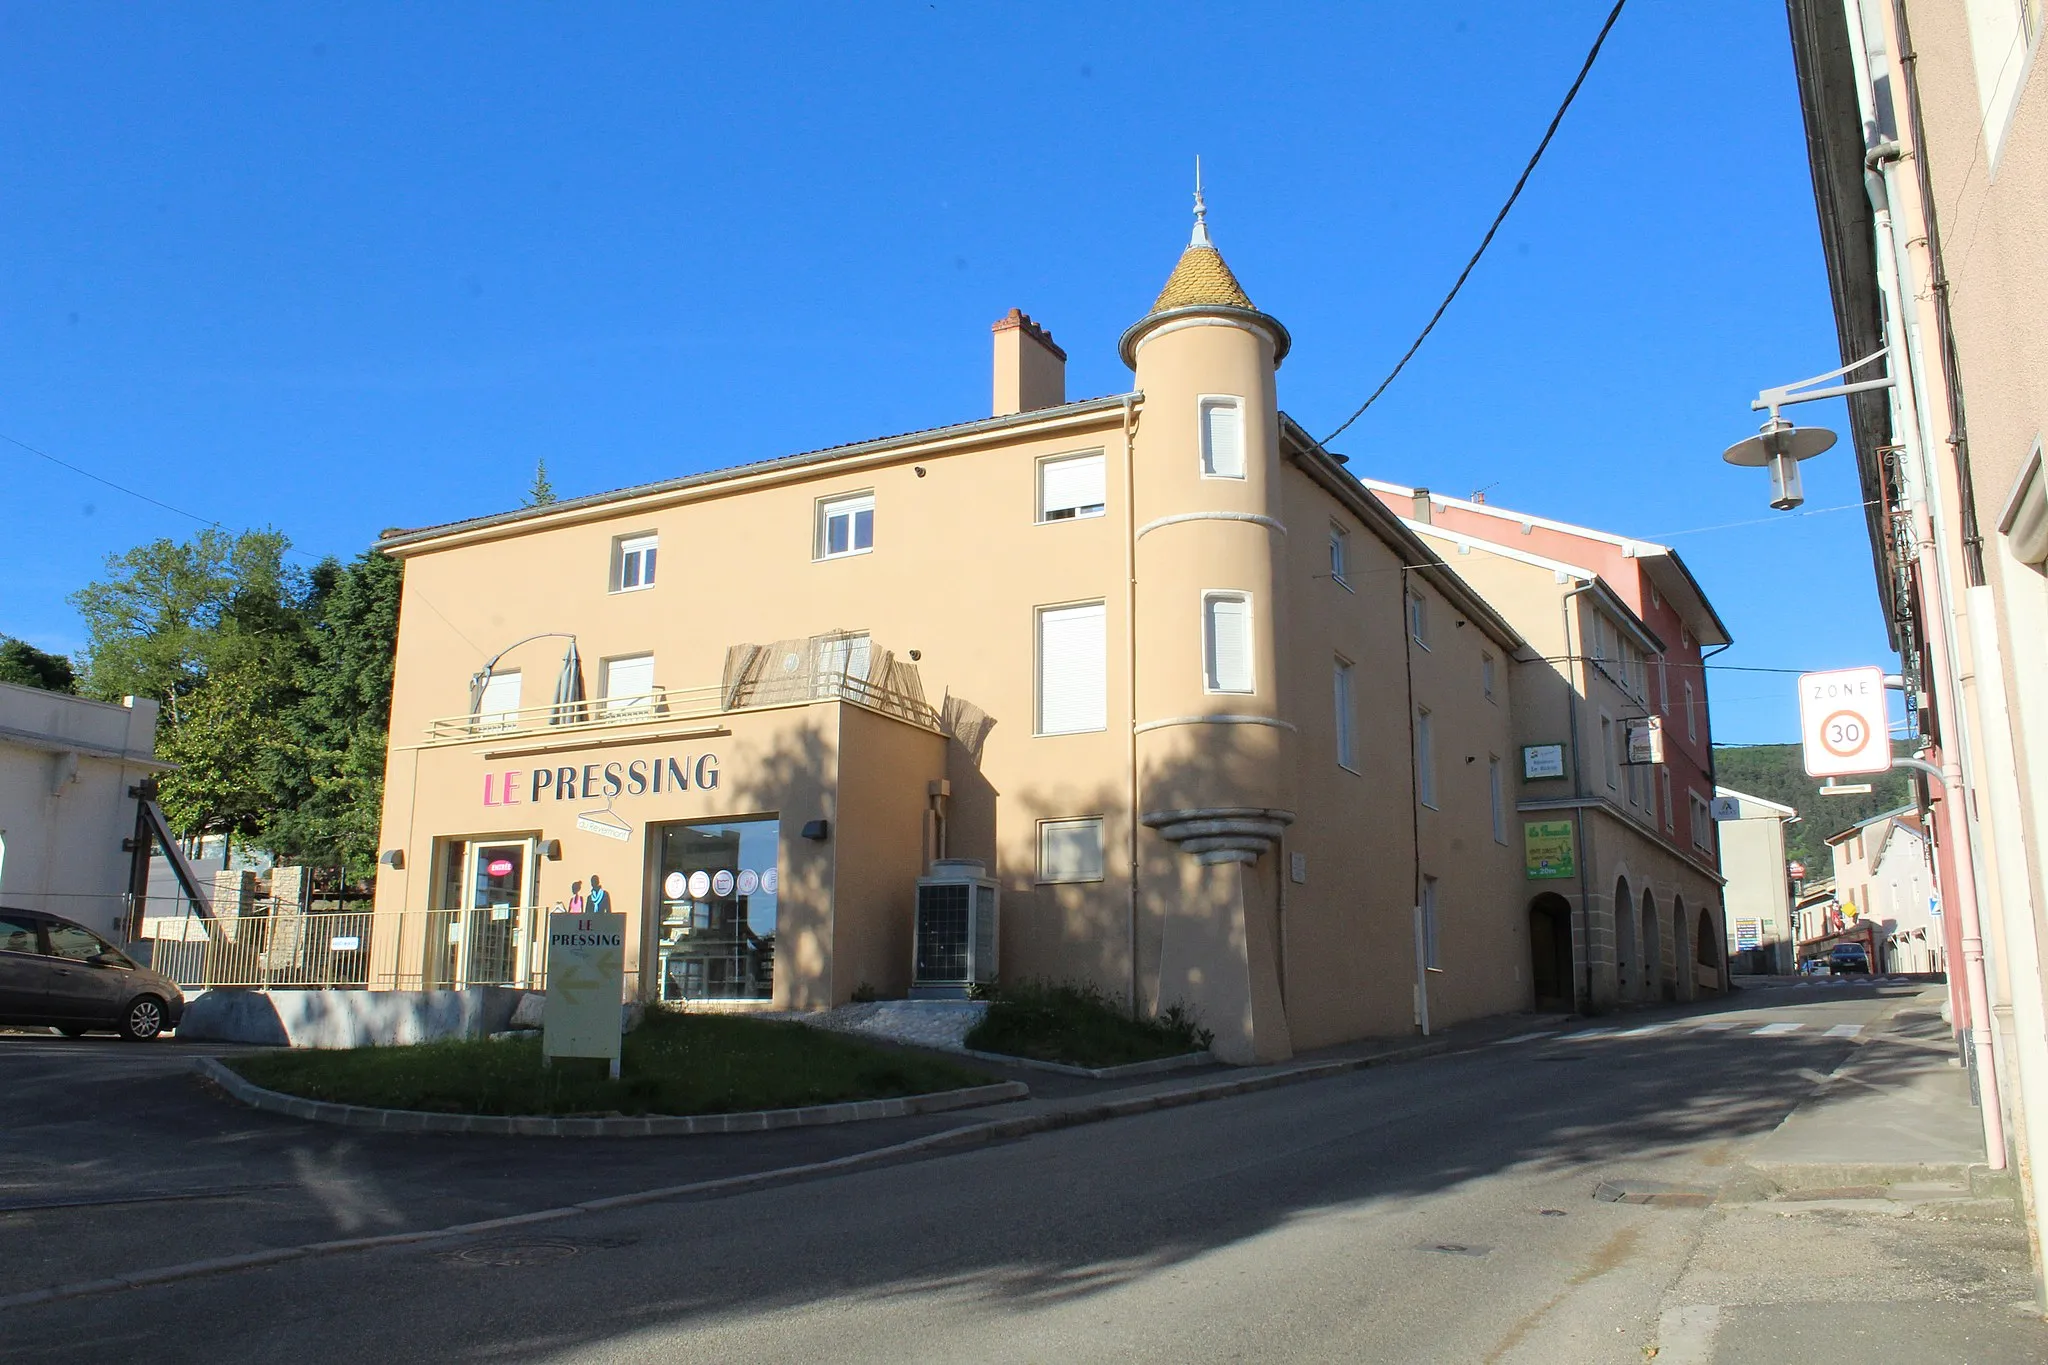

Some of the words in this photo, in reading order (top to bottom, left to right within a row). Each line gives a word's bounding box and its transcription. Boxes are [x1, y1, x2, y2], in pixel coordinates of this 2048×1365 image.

[1814, 681, 1870, 700] ZONE
[1831, 723, 1860, 744] 30
[483, 770, 522, 807] LE
[531, 753, 720, 803] PRESSING
[491, 861, 513, 872] ENTRÉE
[578, 919, 593, 931] LE
[551, 934, 621, 946] PRESSING
